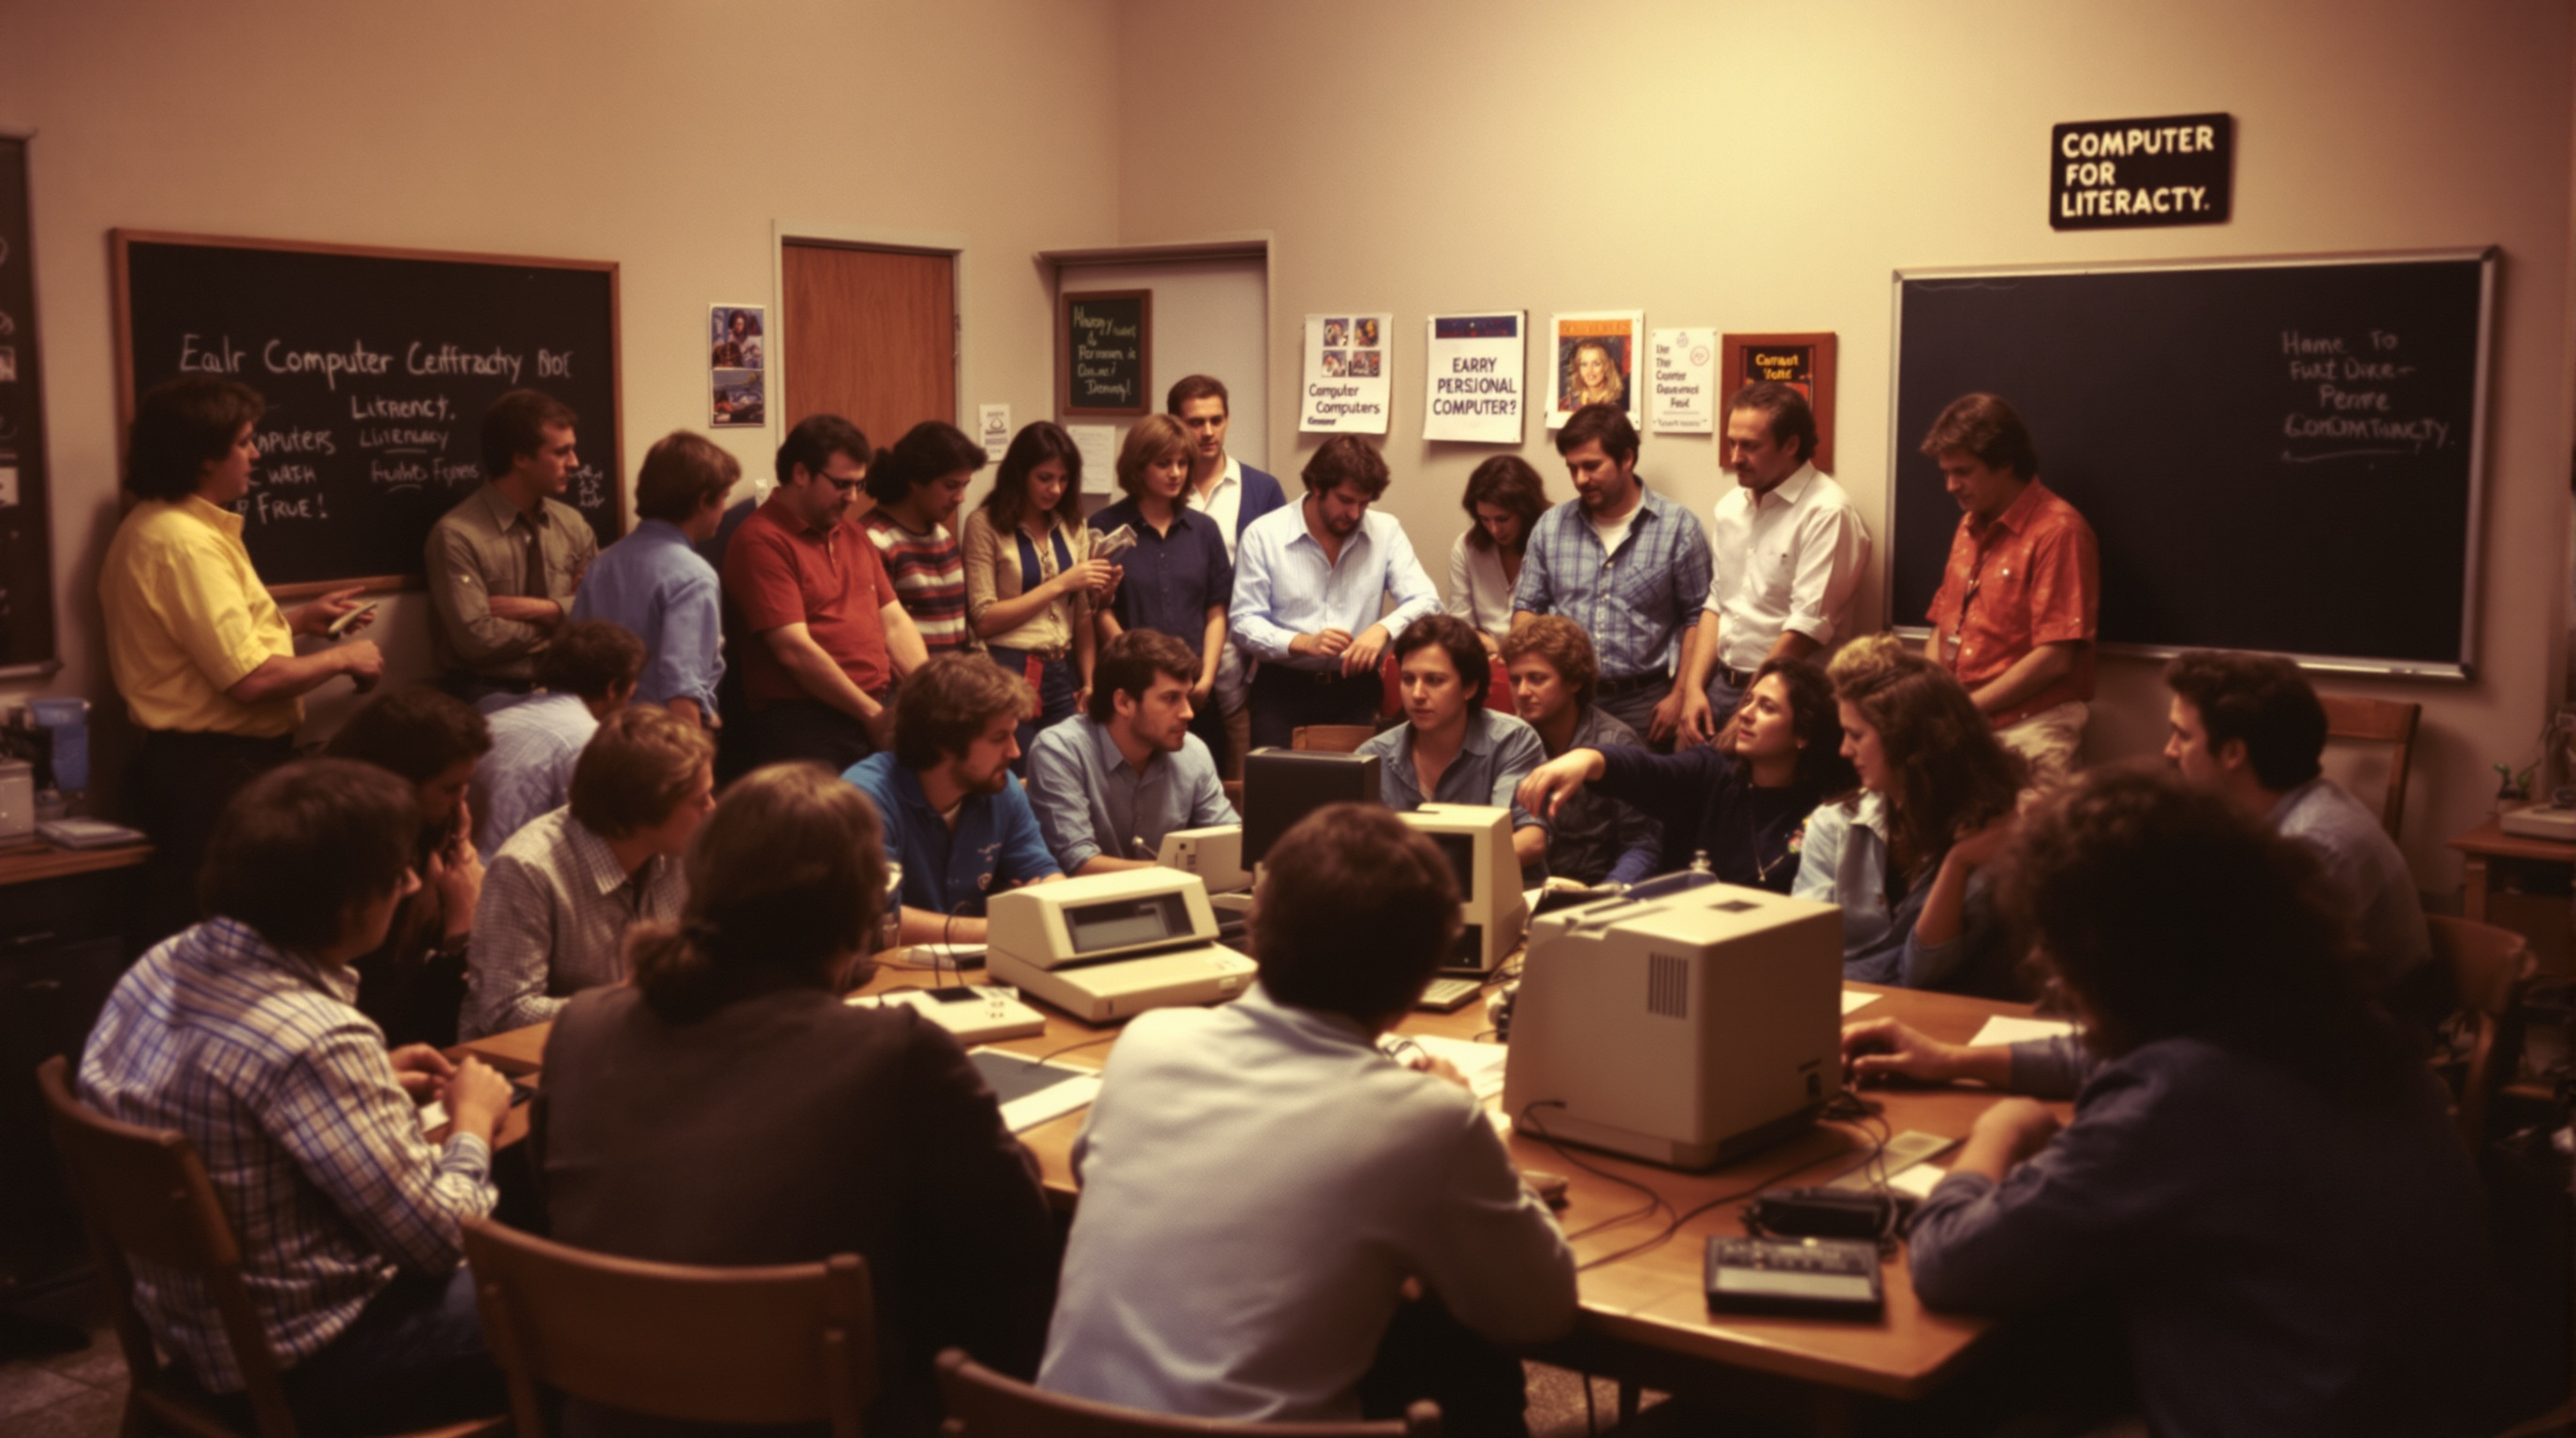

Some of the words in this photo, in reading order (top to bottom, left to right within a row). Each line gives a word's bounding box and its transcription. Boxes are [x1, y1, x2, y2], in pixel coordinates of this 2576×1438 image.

[2062, 125, 2214, 158] COMPUTER
[2066, 160, 2115, 187] FOR
[2061, 186, 2210, 218] LITERACTY.
[264, 339, 394, 390] Computer
[1452, 357, 1498, 374] EARRY
[1437, 377, 1517, 394] PERSIONAL
[1316, 401, 1381, 416] Computers
[1432, 398, 1516, 416] COMPUTER?
